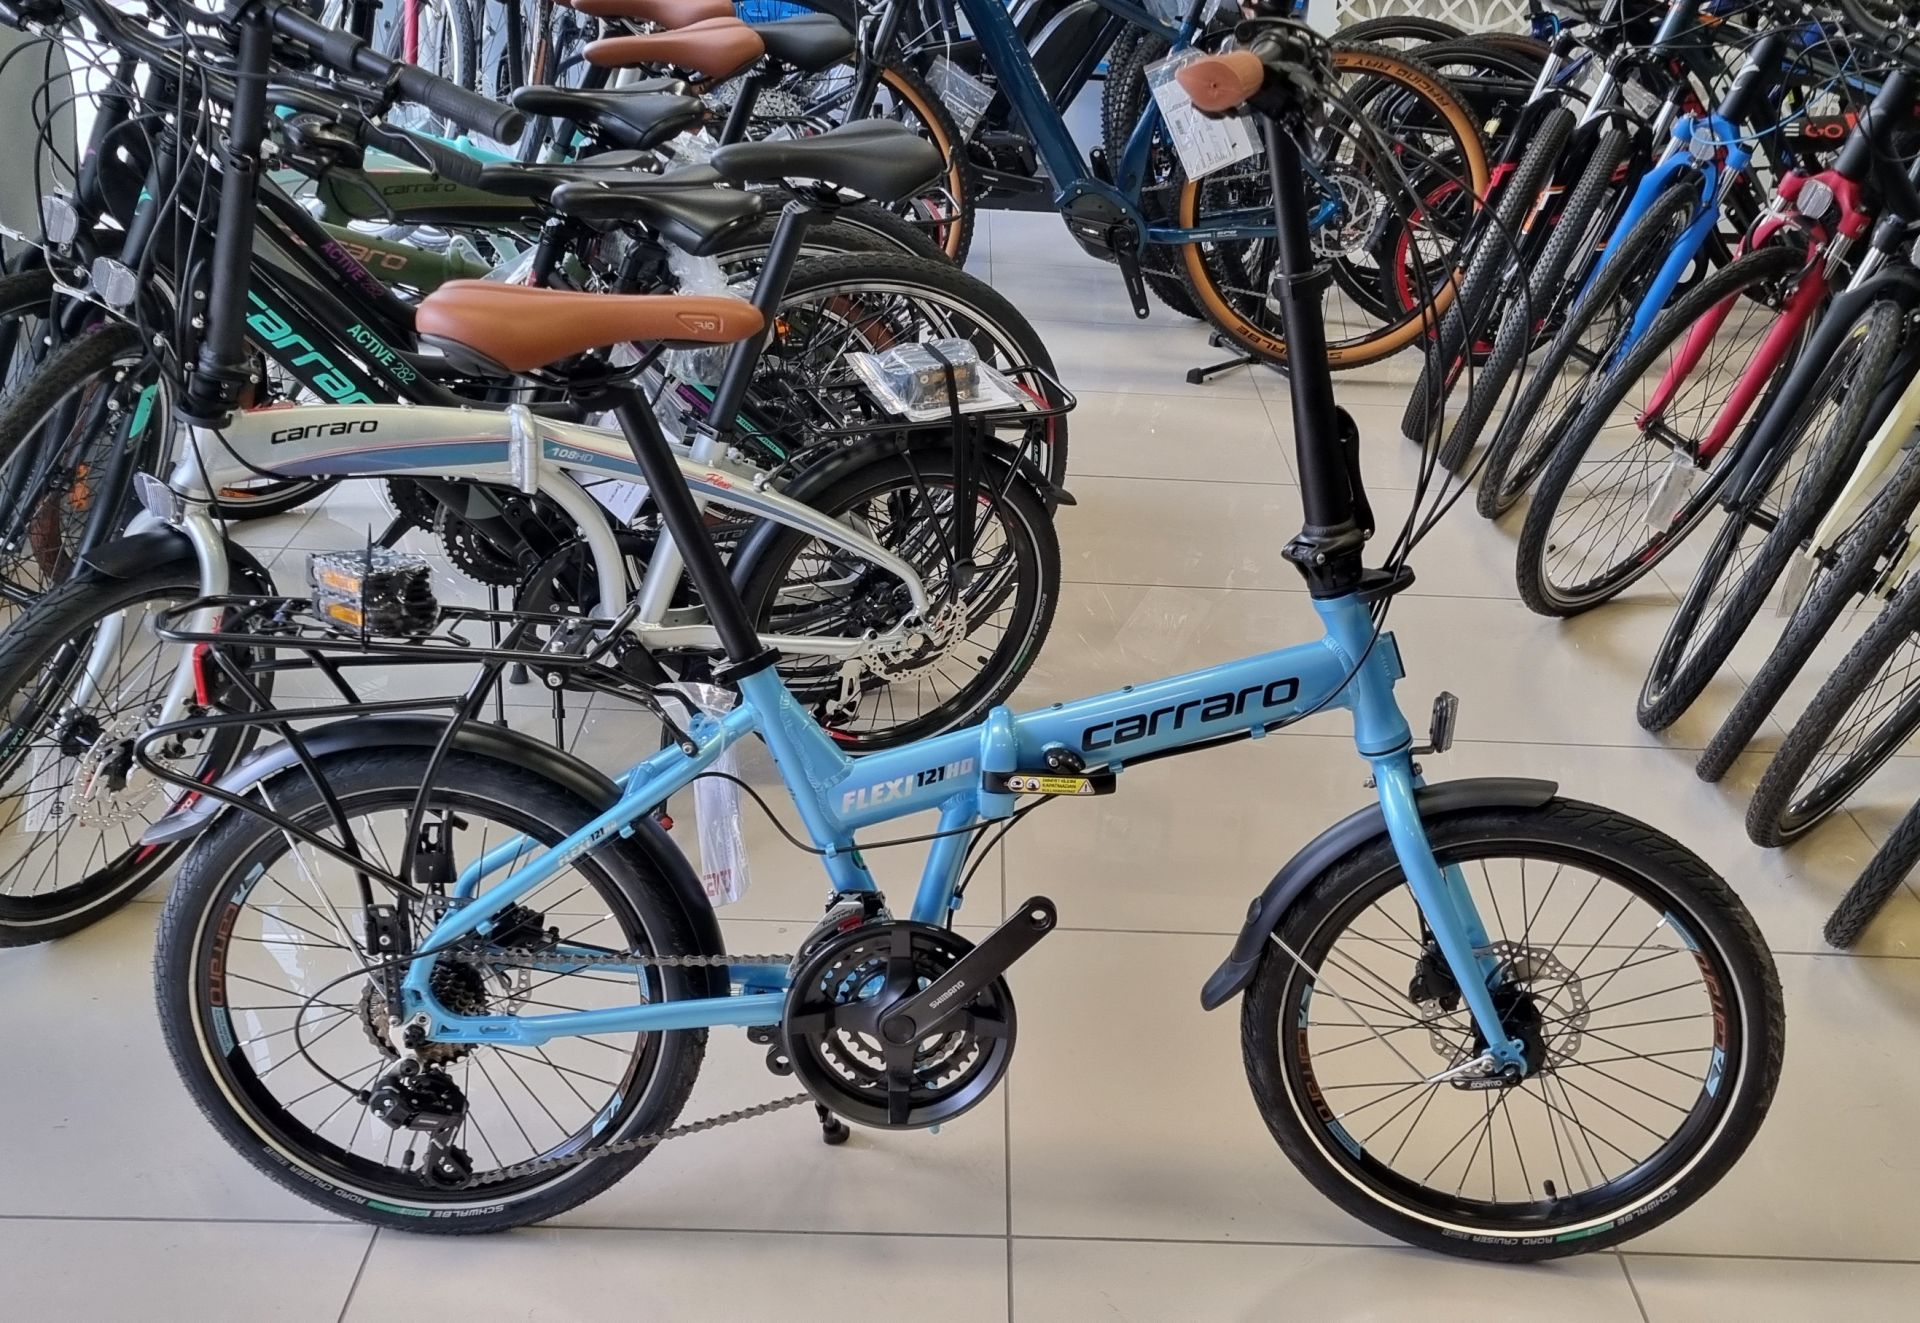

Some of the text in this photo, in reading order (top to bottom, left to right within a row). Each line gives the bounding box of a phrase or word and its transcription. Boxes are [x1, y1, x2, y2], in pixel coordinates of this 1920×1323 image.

[1354, 59, 1449, 109] RACING RAY
[383, 182, 457, 195] carraro
[321, 241, 365, 281] ACTIVE
[347, 324, 417, 385] ACTIVE 282
[271, 420, 379, 445] carraro
[1081, 677, 1300, 752] carraro
[841, 774, 915, 814] FLEXI
[209, 902, 239, 1006] carraro
[928, 980, 966, 1009] SHIMANO
[289, 1165, 335, 1191] CRUISER
[334, 1189, 368, 1205] ROAD
[433, 1204, 505, 1218] SCHWALBE
[1472, 1187, 1678, 1246] SCHWALBE ROAD CRUISER
